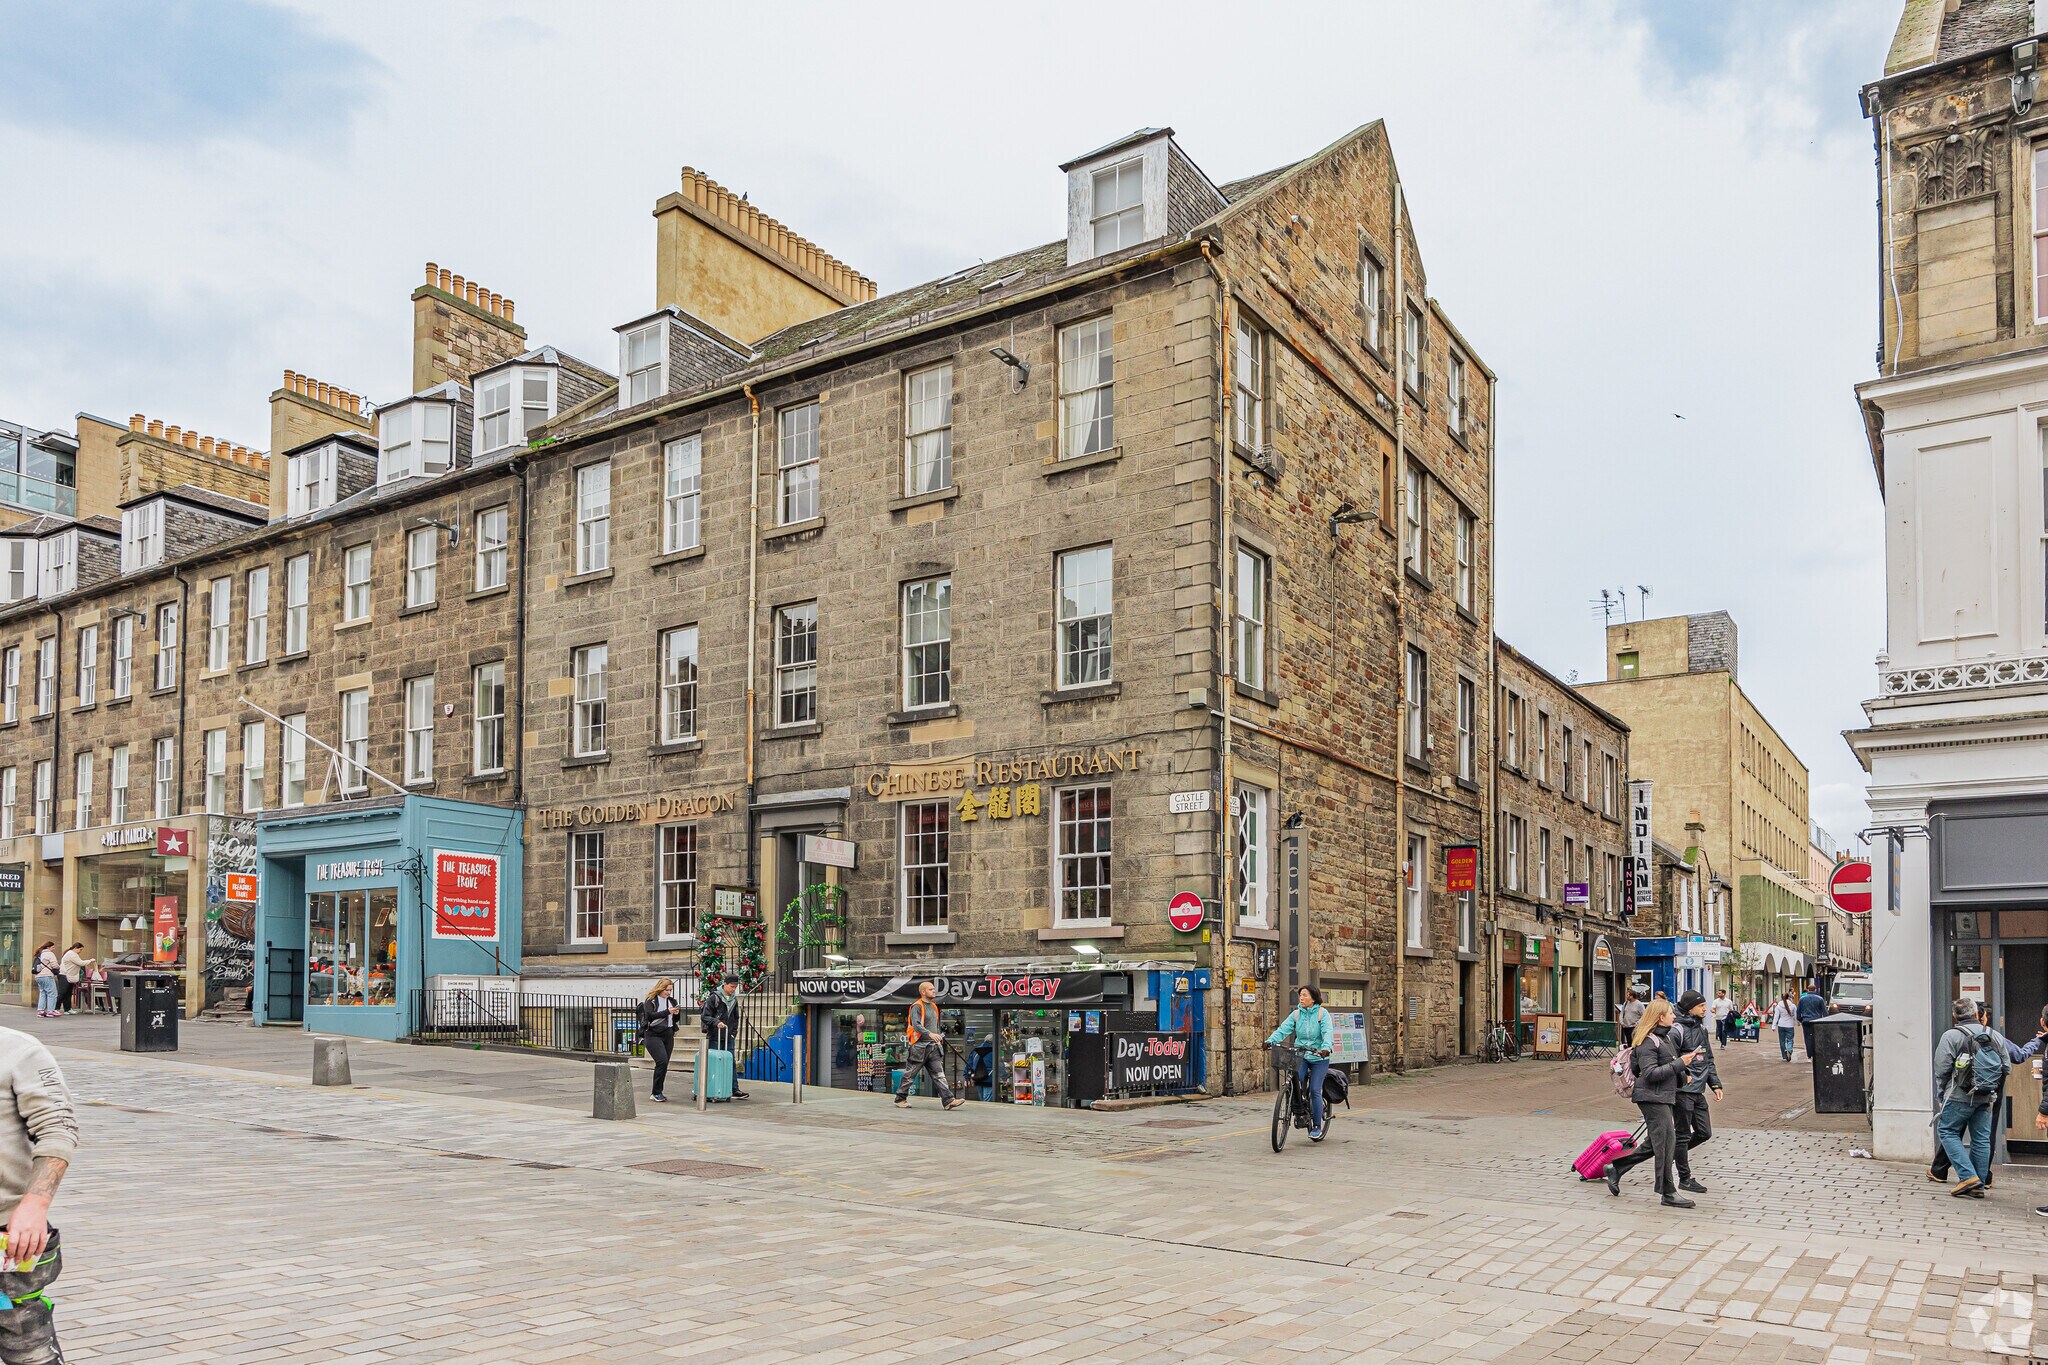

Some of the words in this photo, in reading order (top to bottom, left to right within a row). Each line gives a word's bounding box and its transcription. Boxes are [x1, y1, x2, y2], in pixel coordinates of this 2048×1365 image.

[867, 767, 965, 796] CHINESE
[976, 748, 1144, 787] RESTAURANT
[955, 783, 1041, 822] 金龍閣
[1174, 792, 1205, 802] CASTLE
[1175, 801, 1204, 811] STREET
[539, 809, 573, 829] THE
[578, 803, 650, 826] GOLDEN
[656, 793, 736, 819] DRAGON
[1635, 789, 1649, 888] INDIAN
[317, 863, 329, 881] THE
[330, 861, 361, 880] TREASURE
[443, 860, 455, 873] THE
[459, 861, 492, 877] TREASURE
[457, 875, 478, 889] TROVE
[800, 981, 831, 994] NOW
[831, 980, 866, 993] OPEN
[933, 975, 1061, 1001] Day-Today
[1116, 1036, 1187, 1061] Day-Today
[1125, 1066, 1150, 1082] NOW
[1152, 1064, 1182, 1081] OPEN
